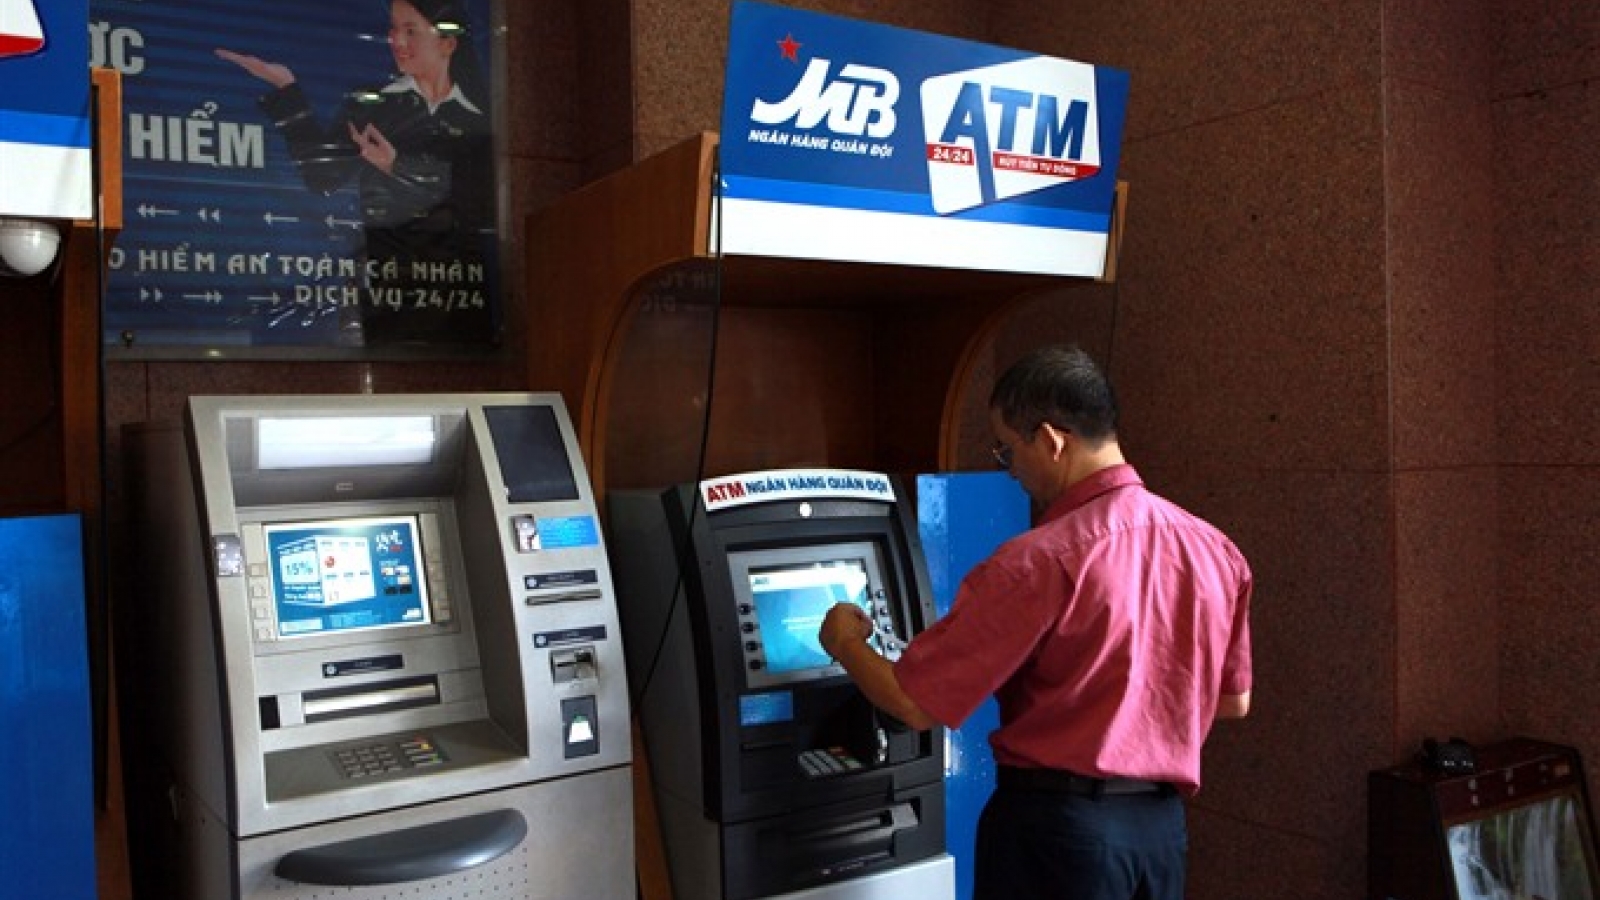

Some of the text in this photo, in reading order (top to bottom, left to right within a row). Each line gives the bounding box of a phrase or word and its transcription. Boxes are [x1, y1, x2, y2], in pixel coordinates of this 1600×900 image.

[751, 57, 900, 137] MB
[129, 101, 264, 168] HIỂM
[932, 147, 971, 163] 24/24
[939, 81, 1089, 200] ATM
[414, 289, 484, 311] 24/24
[707, 481, 746, 503] ATM
